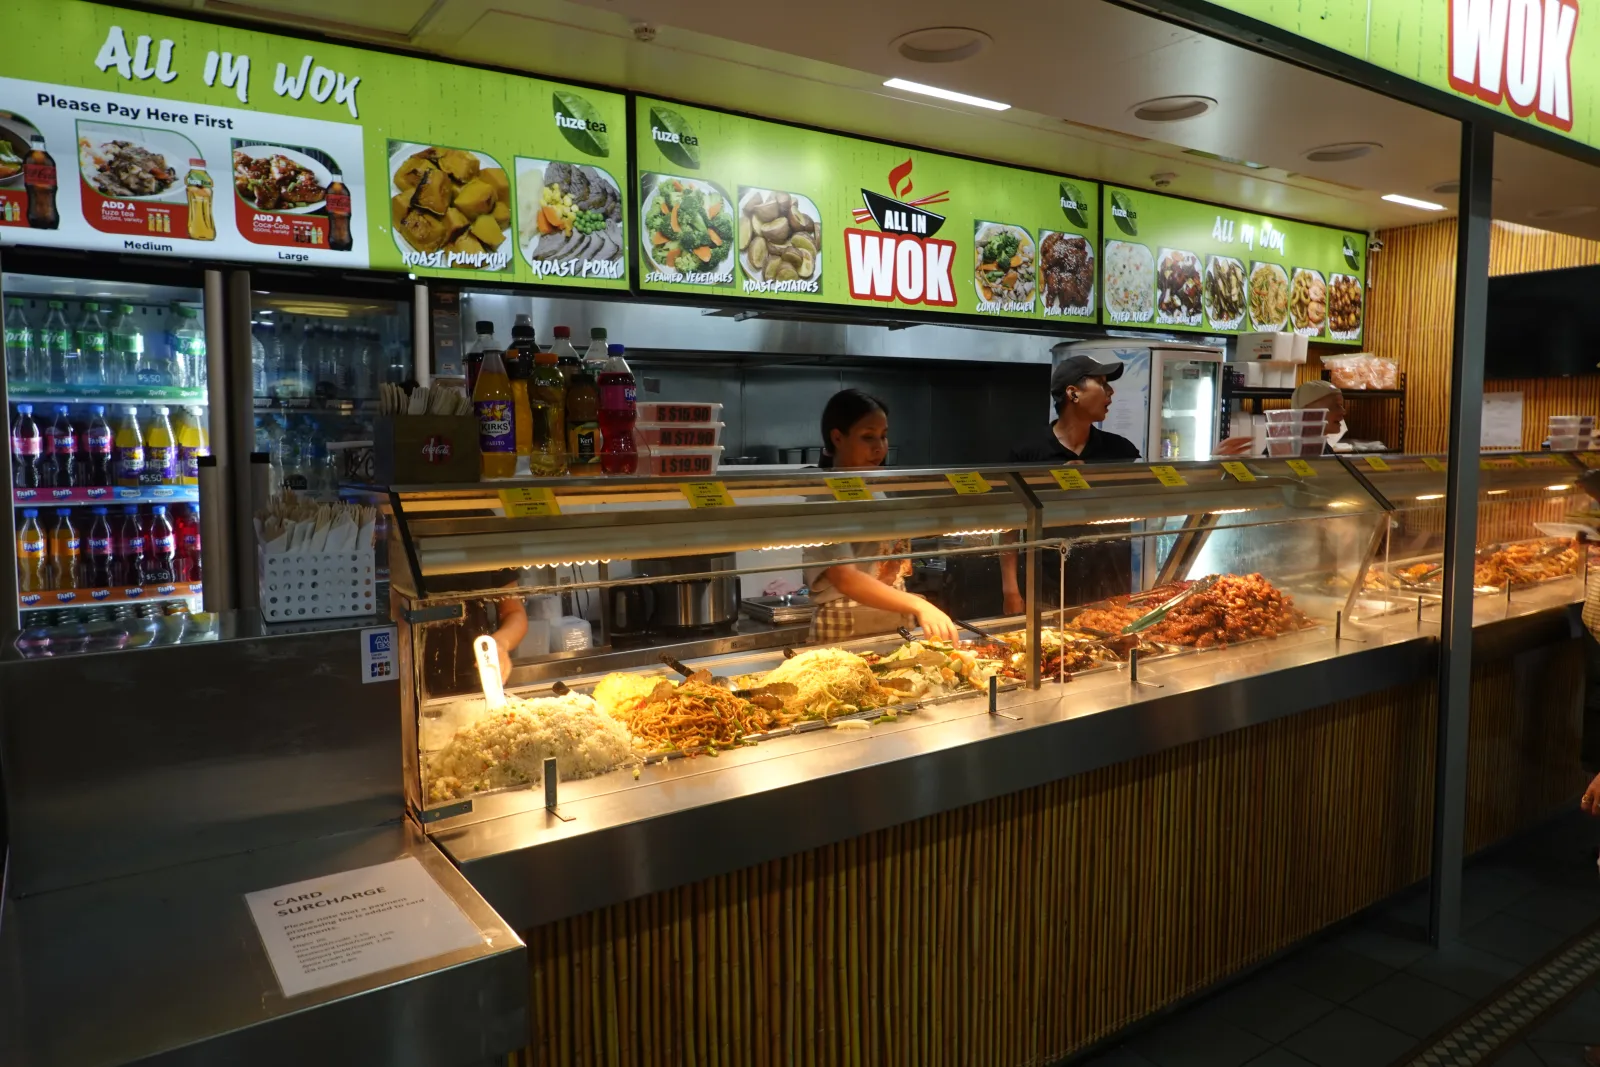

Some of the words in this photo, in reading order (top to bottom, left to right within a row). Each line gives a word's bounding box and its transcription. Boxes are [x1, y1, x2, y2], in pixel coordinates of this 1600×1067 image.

[1453, 0, 1576, 121] WOK
[37, 93, 101, 114] Please
[107, 101, 141, 120] Pay
[147, 107, 189, 125] Here
[194, 114, 234, 130] First
[102, 200, 125, 210] ADD
[127, 202, 135, 211] A
[253, 214, 274, 222] ADD
[884, 209, 908, 232] ALL
[912, 212, 927, 234] IN
[253, 221, 290, 230] Coca-Cola
[124, 240, 173, 252] Medium
[278, 252, 308, 261] Large
[402, 249, 446, 268] ROAST
[448, 250, 508, 269] PUMPKIN
[532, 259, 578, 280] ROAST
[581, 259, 621, 280] PORK
[848, 233, 954, 303] WOK
[644, 271, 684, 285] STEAMED
[686, 271, 734, 284] VEGETABLES
[743, 279, 772, 294] ROAST
[774, 280, 819, 295] POTATOES
[976, 302, 1000, 315] CURRY
[1004, 301, 1035, 314] CHICKEN
[1064, 306, 1090, 317] CHICKEN
[1110, 312, 1130, 324] FRIED
[1132, 311, 1149, 322] RICE
[138, 374, 160, 383] $5.50
[624, 388, 636, 398] FAN
[482, 422, 508, 432] KIRKS
[662, 458, 667, 473] L
[670, 457, 710, 473] $19.90
[140, 474, 162, 482] $5.50
[146, 572, 168, 581] $5.50
[274, 891, 322, 906] CARD
[278, 886, 386, 917] SURCHARGE
[283, 920, 314, 930] Please
[367, 898, 408, 910] payment
[285, 921, 336, 936] processing
[363, 907, 392, 916] added
[288, 926, 340, 942] payments.
